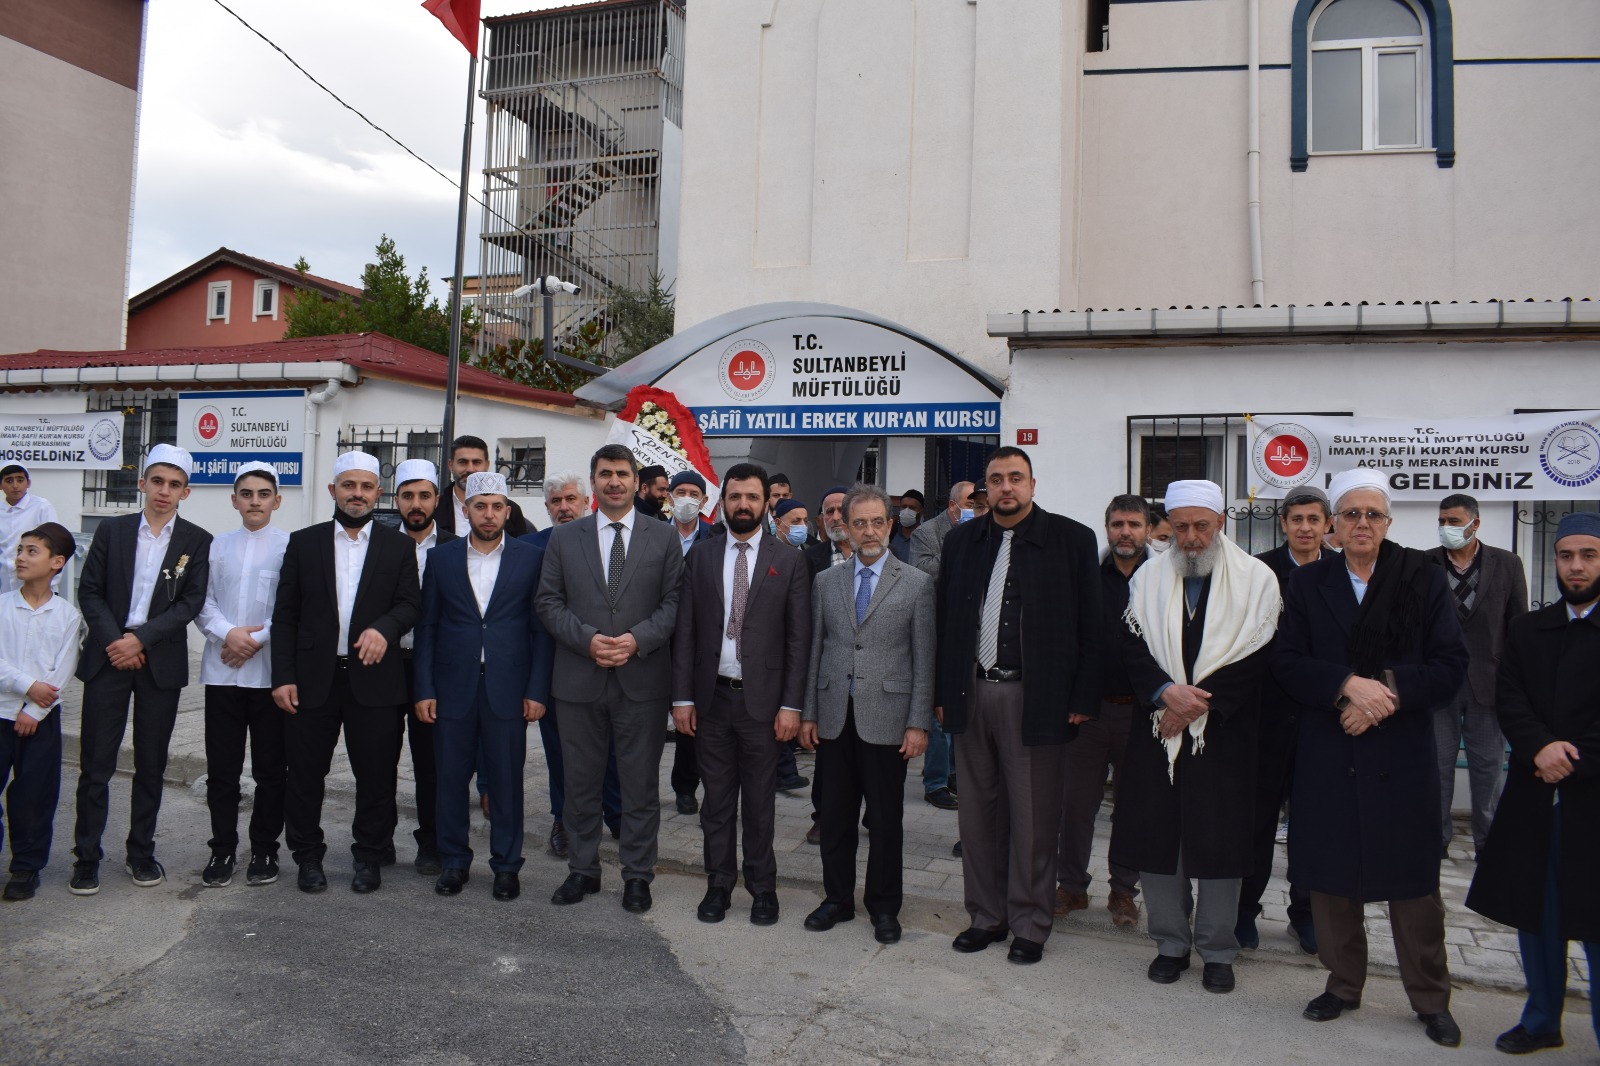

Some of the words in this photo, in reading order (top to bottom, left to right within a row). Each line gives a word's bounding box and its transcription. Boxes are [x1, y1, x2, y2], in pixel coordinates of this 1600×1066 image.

[793, 333, 823, 350] T.C.
[792, 350, 906, 374] SULTANBEYLİ
[792, 375, 901, 397] MÜFTÜLÜĞÜ
[231, 407, 247, 417] T.C.
[746, 412, 796, 429] YATILI
[802, 411, 858, 429] ERKEK
[863, 411, 928, 428] KUR'AN
[934, 410, 996, 428] KURSU
[230, 420, 290, 432] SULTANBEYLİ
[1414, 427, 1439, 435] T.C.
[230, 436, 287, 448] MÜFTÜLÜĞÜ
[1022, 432, 1033, 442] 19
[1333, 435, 1429, 444] SULTANBEYLİ
[1434, 432, 1525, 443] MÜFTÜLÜĞÜ
[632, 446, 656, 466] OKTAY
[1328, 445, 1375, 455] İMAM-I
[1379, 445, 1416, 457] ŞAFİİ
[1479, 445, 1530, 454] KURSU
[1357, 458, 1404, 469] AÇILIŞ
[1408, 457, 1499, 467] MERASİMİNE
